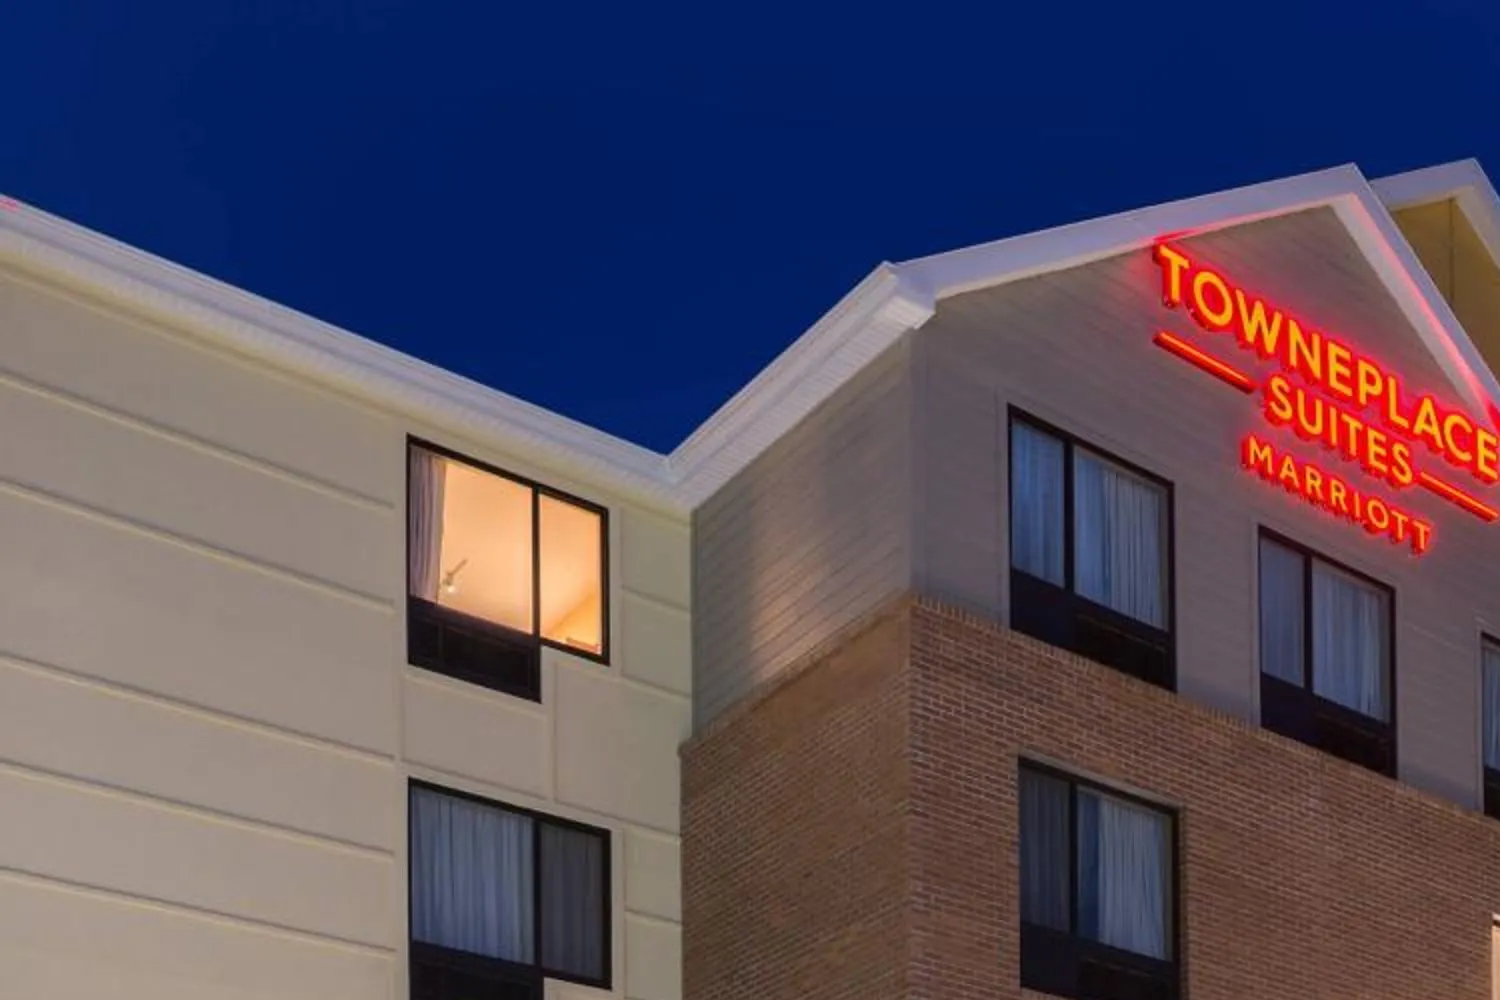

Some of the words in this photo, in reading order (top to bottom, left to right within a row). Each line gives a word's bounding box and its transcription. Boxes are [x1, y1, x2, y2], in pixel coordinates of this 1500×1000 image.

[1155, 244, 1500, 482] TOWNEPLACE
[1265, 376, 1414, 486] SUITES
[1244, 434, 1432, 555] MARRIOTT
